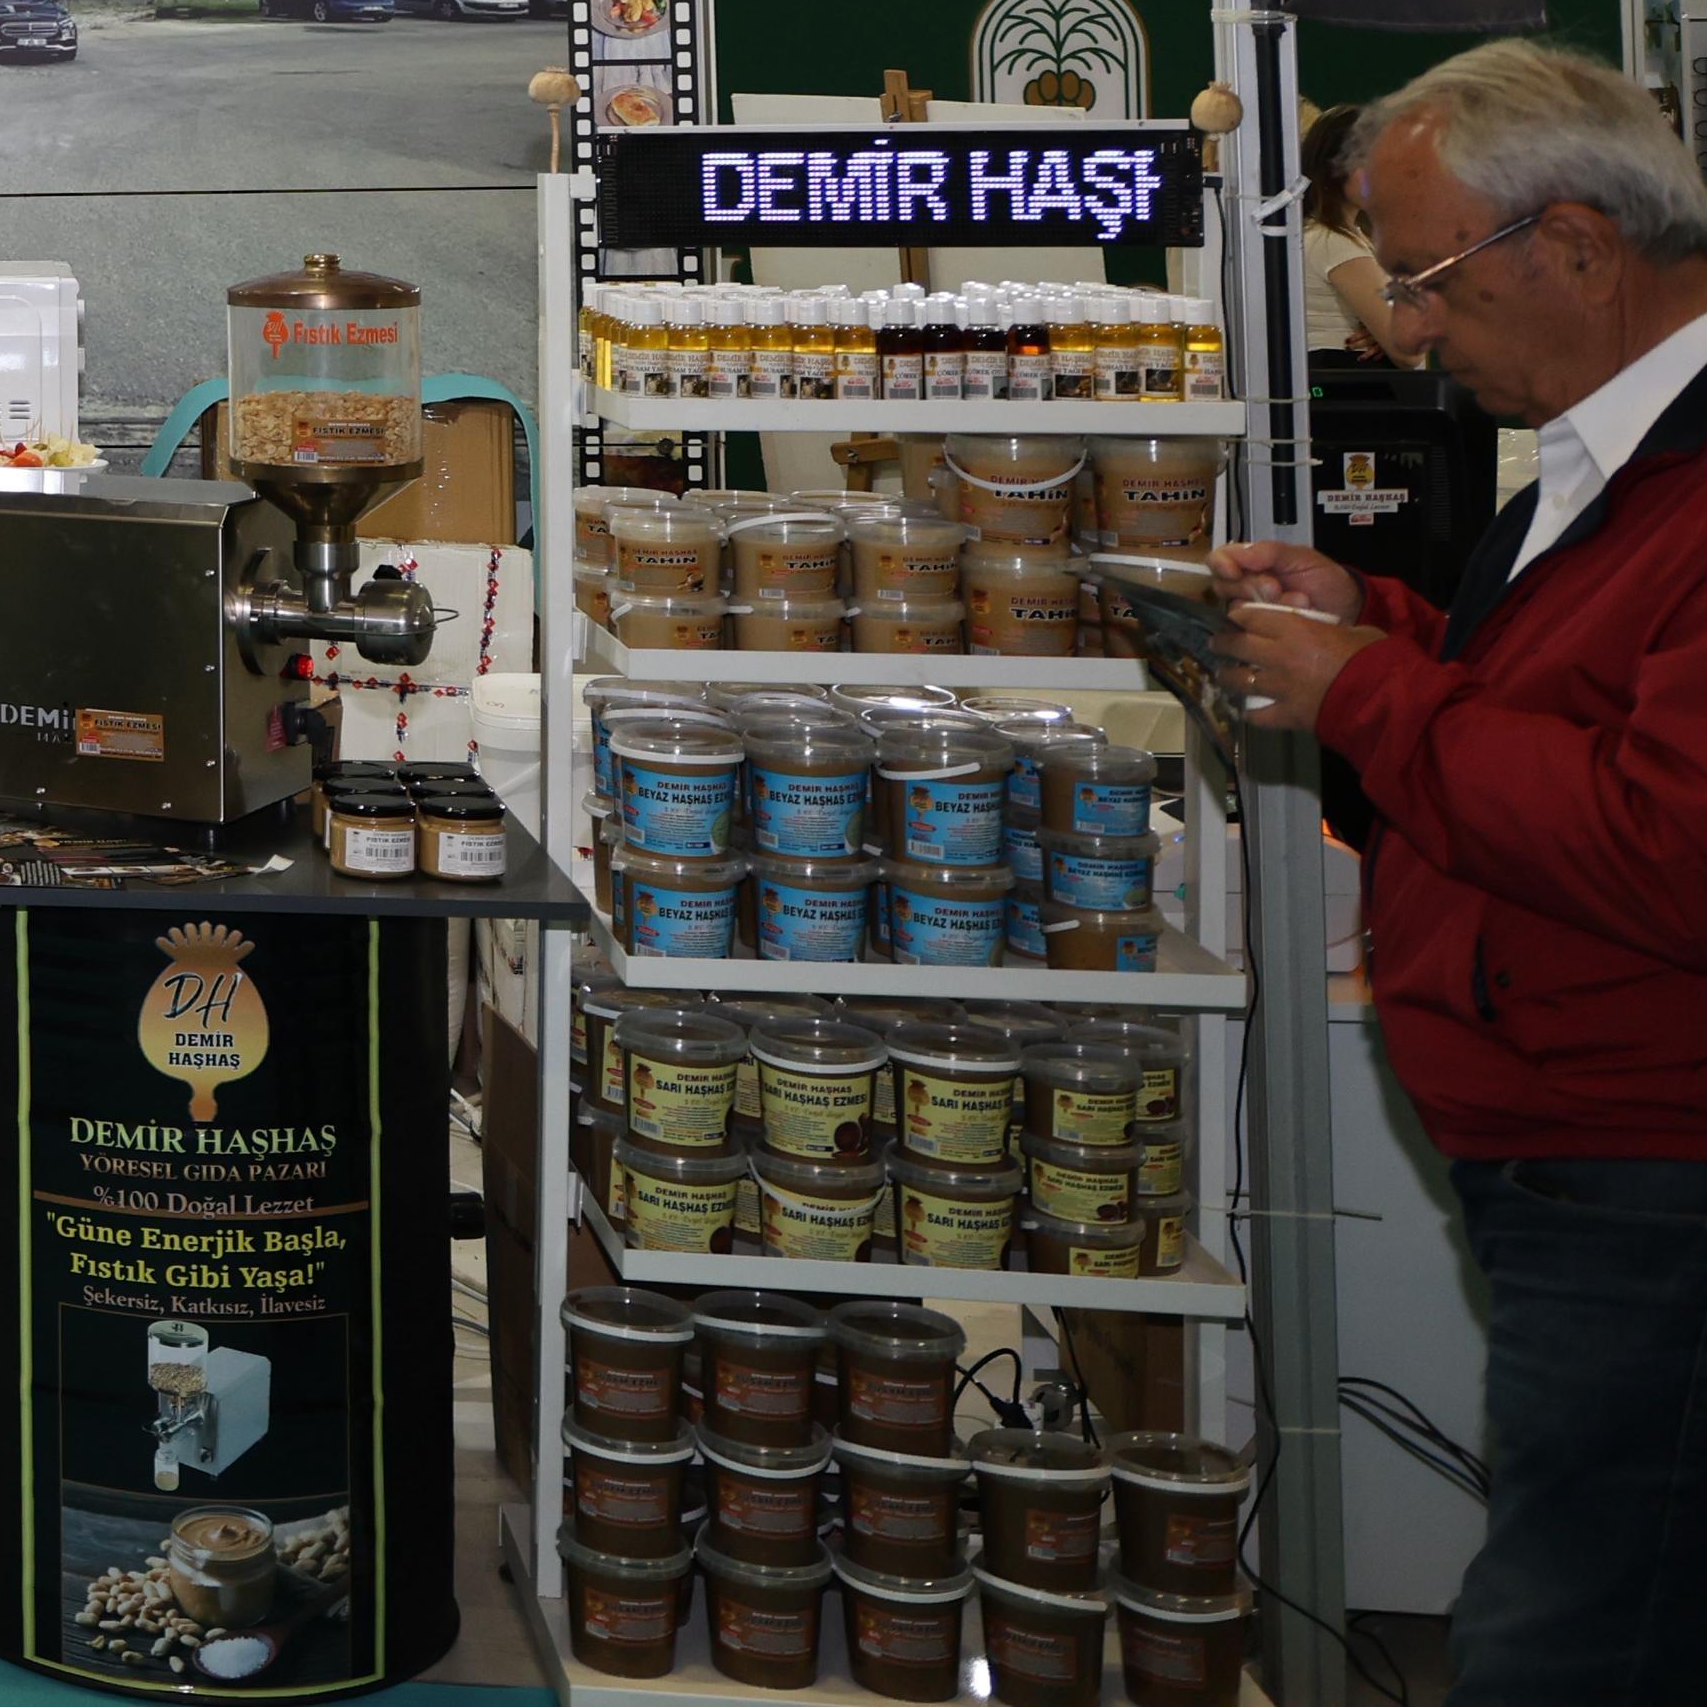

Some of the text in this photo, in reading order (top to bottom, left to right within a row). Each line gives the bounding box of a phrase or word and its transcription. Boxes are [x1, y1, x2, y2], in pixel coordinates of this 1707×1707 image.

[701, 138, 952, 222] DEMİR
[294, 321, 399, 344] Fıstık Ezmesi
[174, 1030, 234, 1048] DEMİR
[168, 1052, 241, 1070] HAŞHAŞ
[69, 1116, 337, 1161] DEMİR HAŞHAŞ
[79, 1152, 326, 1183] YÖRESEL GIDA PAZARI
[93, 1185, 314, 1221] %100 Doğal Lezzet
[141, 1227, 256, 1259] Enerjik
[264, 1226, 347, 1257] Başla,
[70, 1252, 325, 1293] Fıstık Gibi Yaşa!"
[83, 1285, 326, 1317] Şekersiz, Katkısız, İlavesiz
